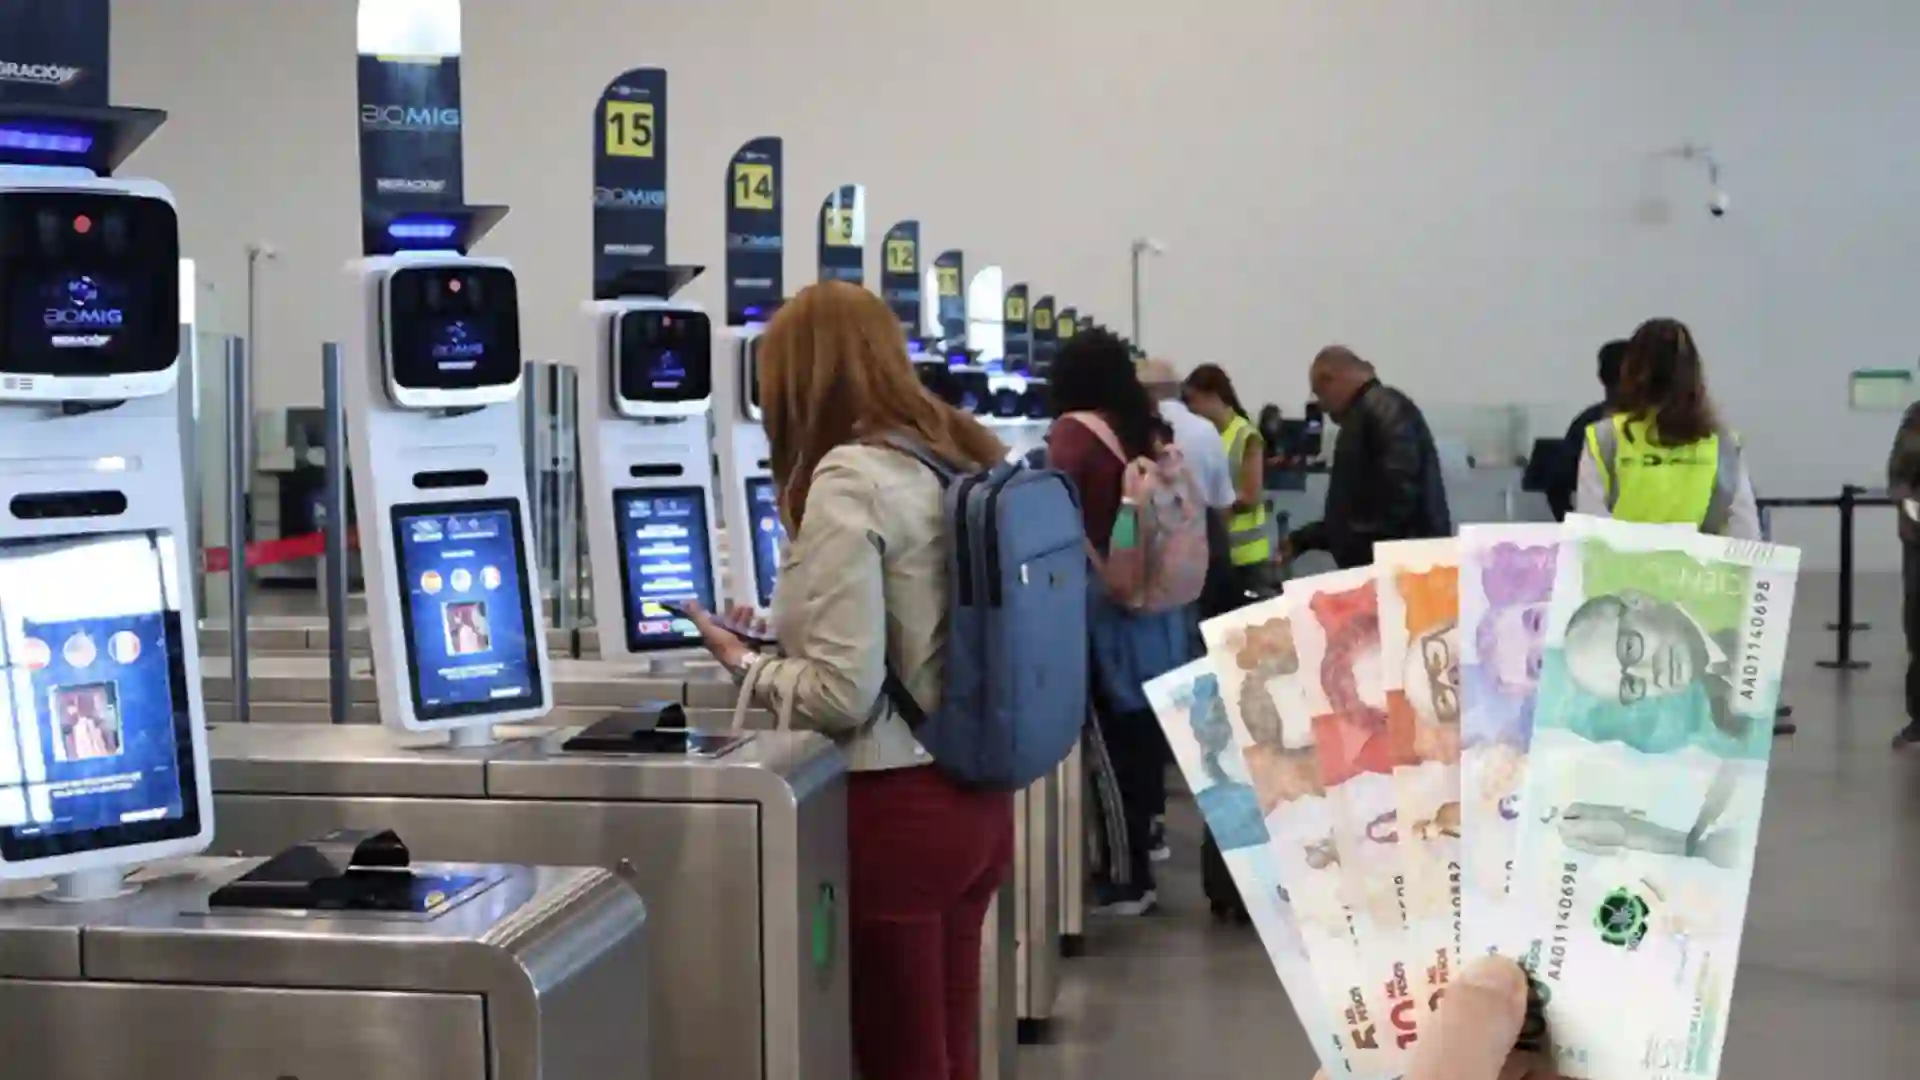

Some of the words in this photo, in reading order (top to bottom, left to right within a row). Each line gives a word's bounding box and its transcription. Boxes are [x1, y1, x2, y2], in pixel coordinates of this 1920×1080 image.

[609, 111, 652, 147] 15
[736, 172, 772, 200] 14
[889, 245, 914, 267] 12
[1740, 581, 1770, 700] AA01140698
[1548, 862, 1578, 980] AA01140698
